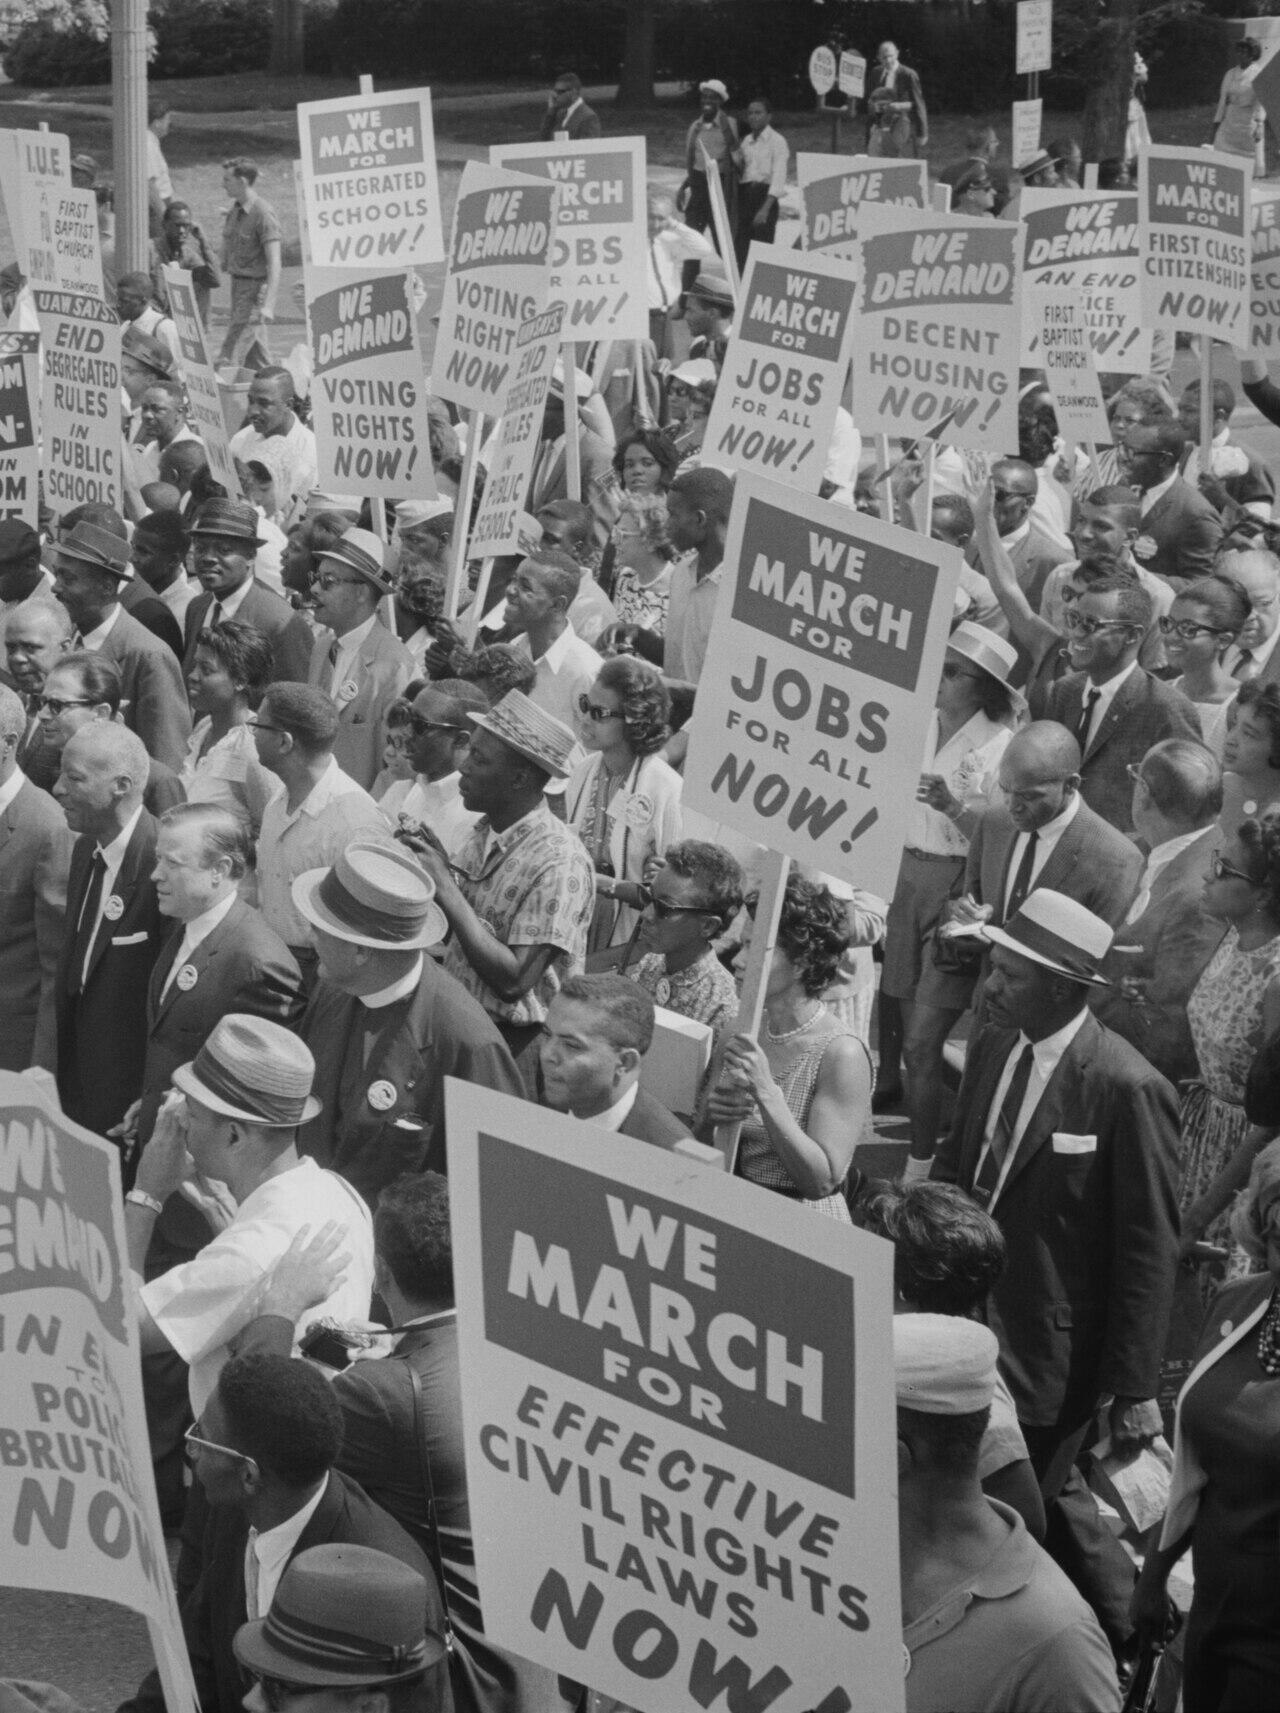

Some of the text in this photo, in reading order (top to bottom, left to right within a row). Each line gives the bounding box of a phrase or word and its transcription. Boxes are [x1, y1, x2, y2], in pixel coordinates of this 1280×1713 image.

[346, 110, 382, 130] WE
[319, 126, 415, 159] MARCH
[26, 144, 65, 178] I.U.E.
[349, 153, 387, 169] FOR
[546, 159, 586, 180] WE
[1186, 164, 1217, 186] WE
[314, 171, 426, 202] INTEGRATED
[557, 179, 623, 206] RCH
[839, 172, 883, 205] WE
[1155, 184, 1239, 217] MARCH
[58, 199, 89, 219] FIRST
[317, 198, 428, 229] SCHOOLS
[484, 190, 524, 225] WE
[557, 209, 590, 222] OR
[1065, 201, 1119, 232] WE
[1186, 211, 1219, 227] FOR
[54, 219, 95, 240] BAPTIST
[329, 223, 425, 263] NOW!
[456, 221, 547, 265] DEMAND
[1028, 223, 1140, 265] DEMAN
[56, 239, 94, 260] CHURCH
[551, 235, 623, 268] OBS
[911, 231, 969, 266] WE
[1149, 232, 1200, 256] FIRST
[1205, 239, 1245, 267] CLASS
[577, 273, 620, 287] ALL
[785, 273, 818, 302] WE
[870, 262, 1010, 304] DEMAND
[1034, 270, 1137, 288] AN END
[1145, 256, 1246, 292] CITIZENSHIP
[38, 292, 73, 315] UAW
[338, 284, 374, 323] WE
[455, 277, 537, 320] VOTING
[749, 293, 840, 338] MARCH
[1044, 305, 1075, 324] FIRST
[1158, 291, 1241, 329] NOW!
[55, 322, 105, 354] END
[318, 309, 407, 366] DEMAND
[453, 314, 516, 355] RIGHT
[771, 329, 806, 350] FOR
[882, 316, 1000, 356] DECENT
[1042, 328, 1084, 346] BAPTIST
[45, 349, 118, 389] SEGREGATED
[869, 351, 1009, 396] HOUSING
[1047, 351, 1087, 369] CHURCH
[321, 377, 417, 409] VOTING
[735, 358, 824, 406] JOBS
[54, 382, 108, 419] RULES
[731, 395, 811, 429] FOR ALL
[878, 384, 1001, 432] NOW!
[70, 422, 90, 441] IN
[332, 412, 415, 443] RIGHTS
[51, 436, 114, 477] PUBLIC
[334, 444, 418, 481] NOW!
[718, 423, 815, 473] NOW!
[49, 468, 116, 507] SCHOOLS
[809, 531, 866, 583] WE
[748, 552, 913, 652] MARCH
[789, 617, 854, 660] FOR
[730, 654, 890, 754] JOBS
[725, 709, 872, 789] FOR ALL
[710, 752, 879, 854] NOW!
[604, 1193, 717, 1293] WE
[507, 1229, 825, 1424] MARCH
[603, 1346, 728, 1432] FOR
[515, 1383, 840, 1561] EFFECTIVE
[479, 1423, 870, 1633] CIVIL RIGHTS
[581, 1521, 759, 1640] LAWS
